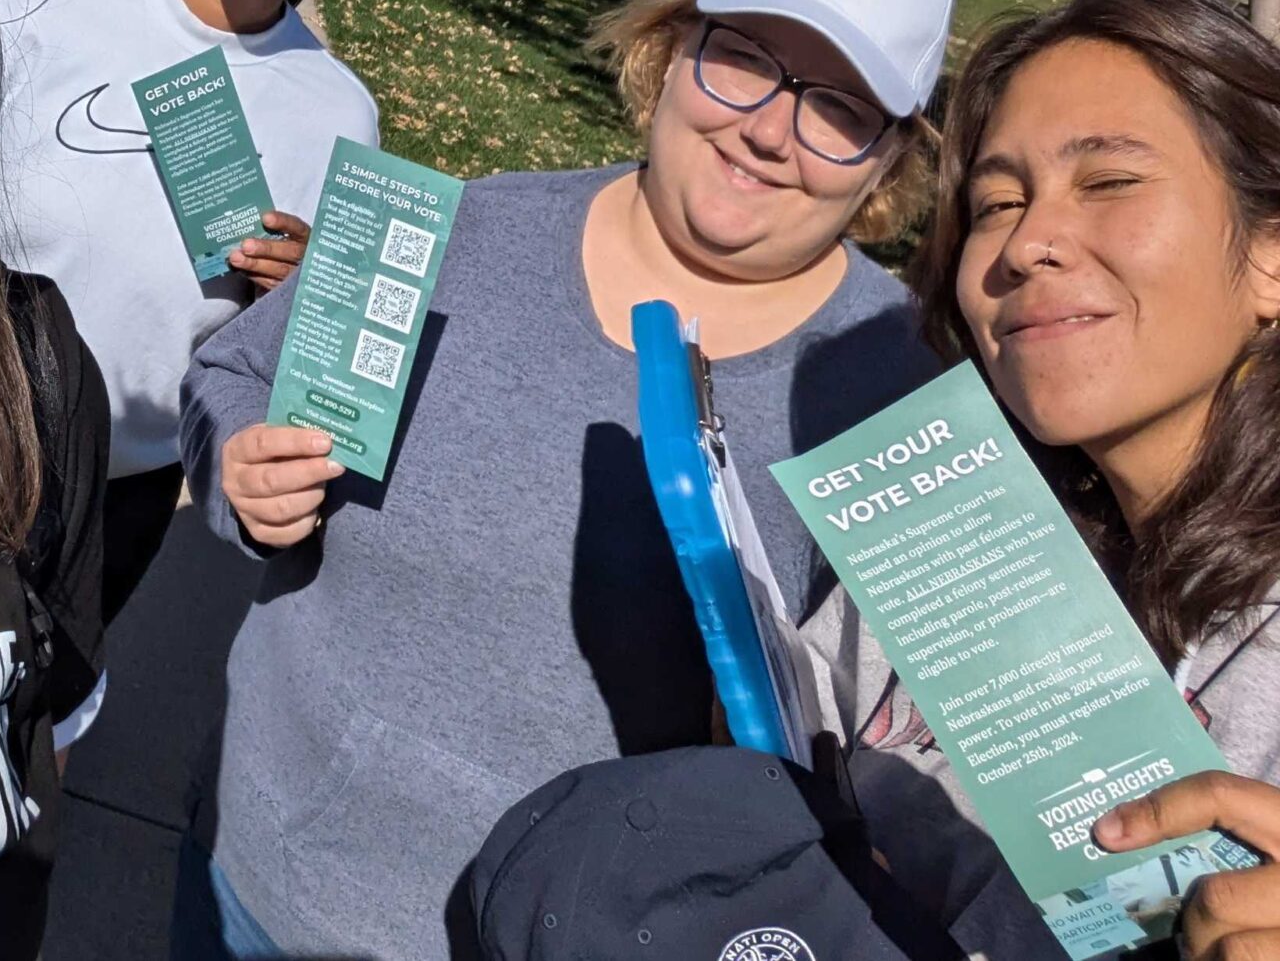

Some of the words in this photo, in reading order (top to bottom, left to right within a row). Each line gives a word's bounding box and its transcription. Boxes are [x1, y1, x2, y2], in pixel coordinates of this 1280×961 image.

[145, 83, 169, 101] GET
[171, 67, 208, 89] YOUR
[150, 95, 186, 116] VOTE
[187, 76, 226, 101] BACK!
[335, 174, 381, 198] RESTORE
[383, 191, 412, 210] YOUR
[414, 204, 442, 222] VOTE
[342, 162, 350, 171] 3
[350, 165, 388, 186] SIMPLE
[389, 180, 421, 199] STEPS
[423, 192, 438, 205] TO
[204, 217, 231, 232] VOTING
[231, 206, 258, 222] RIGHTS
[216, 224, 255, 242] COALITION
[808, 463, 863, 498] GET
[864, 419, 954, 471] YOUR
[825, 483, 911, 531] VOTE
[910, 437, 1003, 495] BACK!
[846, 533, 907, 566] Nebraska's
[905, 511, 954, 538] Supreme
[954, 495, 986, 515] Court
[984, 486, 1006, 500] has
[856, 558, 893, 582] issued
[893, 553, 909, 565] an
[908, 533, 951, 558] opinion
[949, 527, 963, 538] to
[963, 512, 992, 532] allow
[866, 563, 931, 598] Nebraskans
[930, 550, 957, 567] with
[955, 538, 980, 559] past
[979, 518, 1023, 544] felonies
[1022, 512, 1035, 523] to
[876, 597, 905, 613] vote.
[906, 584, 932, 602] ALL
[928, 546, 1006, 591] NEBRASKANS
[1004, 536, 1029, 553] who
[1027, 523, 1056, 541] have
[887, 596, 945, 630] completed
[944, 595, 954, 604] a
[952, 577, 987, 599] felony
[895, 617, 951, 647] including
[949, 600, 989, 625] parole,
[988, 567, 1052, 607] post-release
[907, 629, 974, 663] supervision,
[974, 620, 987, 632] or
[917, 656, 958, 680] eligible
[957, 650, 971, 661] to
[970, 638, 999, 655] vote.
[938, 697, 965, 716] Join
[964, 684, 989, 702] over
[988, 669, 1020, 690] 7,000
[1019, 650, 1062, 676] directly
[1059, 623, 1114, 656] impacted
[946, 696, 1013, 732] Nebraskans
[1012, 683, 1036, 702] and
[1034, 666, 1078, 691] reclaim
[1076, 653, 1103, 674] your
[957, 727, 998, 753] power.
[995, 718, 1013, 731] To
[1012, 707, 1039, 723] vote
[1036, 701, 1052, 712] in
[1051, 691, 1072, 706] the
[1070, 677, 1097, 696] 2024
[1096, 655, 1143, 683] General
[966, 741, 1018, 767] Election,
[1017, 729, 1041, 748] you
[1039, 714, 1070, 734] must
[1068, 694, 1112, 721] register
[1110, 677, 1150, 700] before
[977, 758, 1023, 784] October
[1022, 746, 1053, 764] 25th,
[1051, 731, 1083, 751] 2024.
[1038, 788, 1108, 828] VOTING
[1105, 758, 1174, 799] RIGHTS
[1066, 908, 1095, 923] WAIT
[1097, 902, 1113, 913] TO
[761, 933, 800, 954] OPEN
